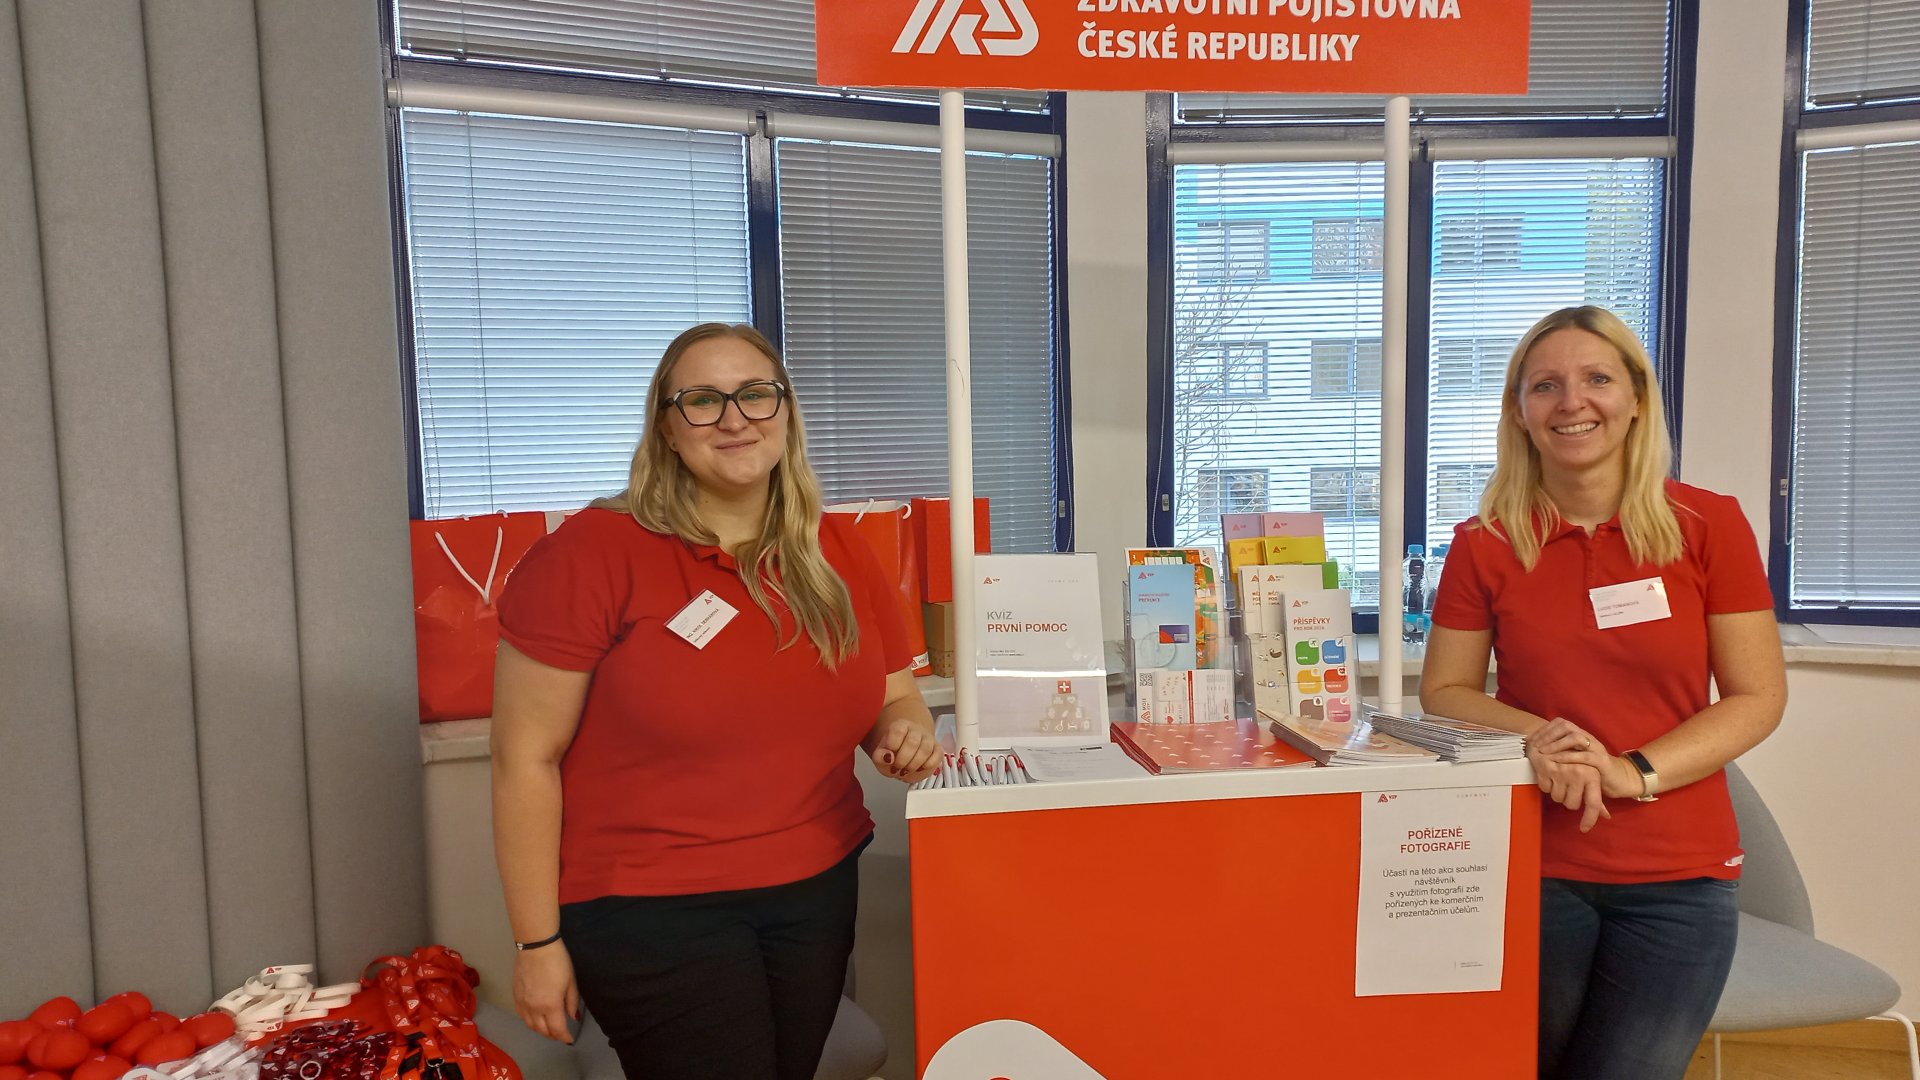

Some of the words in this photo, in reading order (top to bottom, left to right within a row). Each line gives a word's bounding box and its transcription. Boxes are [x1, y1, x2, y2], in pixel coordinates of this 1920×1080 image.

[1077, 20, 1178, 59] ČESKÉ
[1187, 31, 1360, 61] REPUBLIKY
[987, 609, 1012, 620] KVÍZ
[1293, 617, 1331, 625] PŘÍSPĚVKY
[987, 621, 1022, 633] PRVNÍ
[1025, 623, 1068, 633] POMOC
[1408, 826, 1463, 840] POŘÍZENÉ
[1400, 841, 1471, 854] FOTOGRAFIE
[1456, 864, 1488, 873] souhlasí
[1415, 876, 1456, 886] návštěvník
[1466, 885, 1480, 893] zde
[1385, 899, 1428, 909] pořízených
[1441, 895, 1484, 905] komerčním
[1395, 908, 1449, 919] prezentačním
